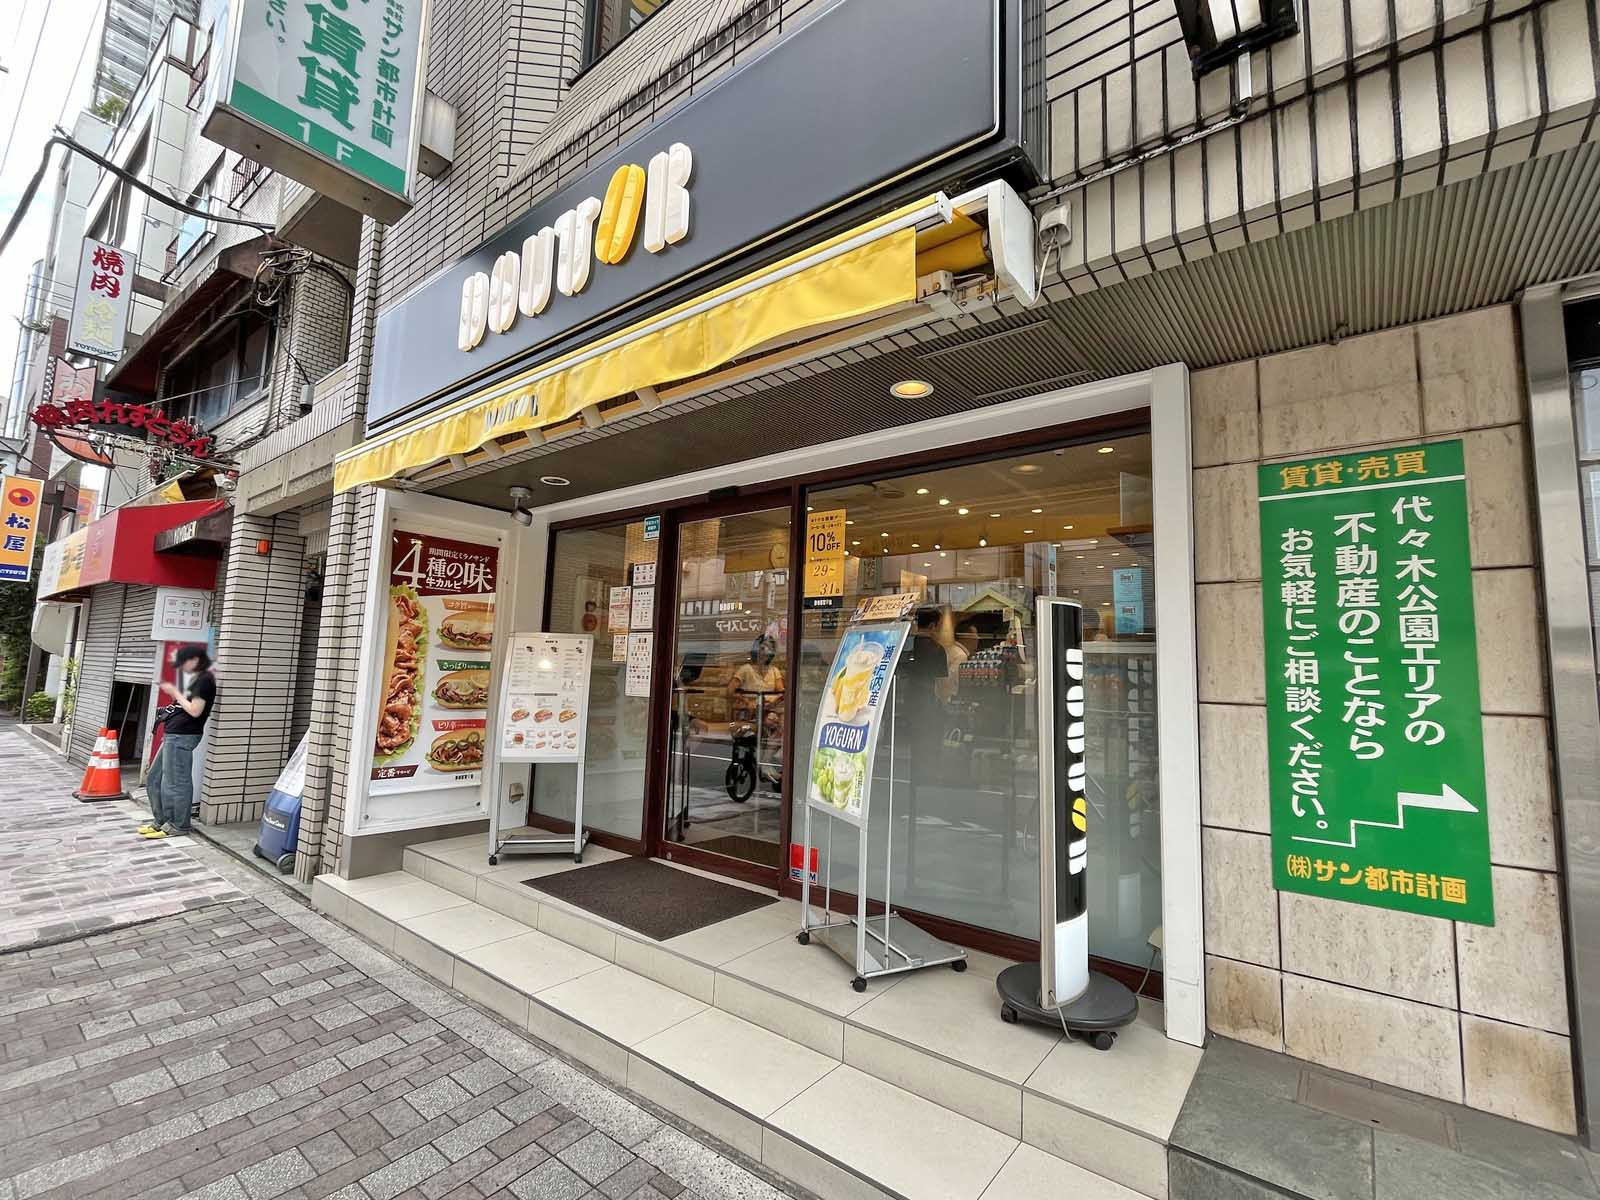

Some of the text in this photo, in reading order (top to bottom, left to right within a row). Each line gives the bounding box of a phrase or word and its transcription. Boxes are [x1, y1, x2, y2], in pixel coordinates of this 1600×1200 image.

[297, 0, 367, 131] 賃貸
[370, 15, 404, 148] サン都市計画
[458, 142, 693, 352] DOUTOR
[4, 512, 31, 552] 松屋
[1280, 450, 1428, 490] 賃貸・売買
[426, 577, 463, 590] 牛カルビ
[1333, 511, 1386, 760] 不動産のことなら
[1391, 495, 1446, 746] 代々木公園エリアの
[824, 725, 864, 750] YOGURN
[1280, 527, 1329, 830] お気軽にご相談ください。
